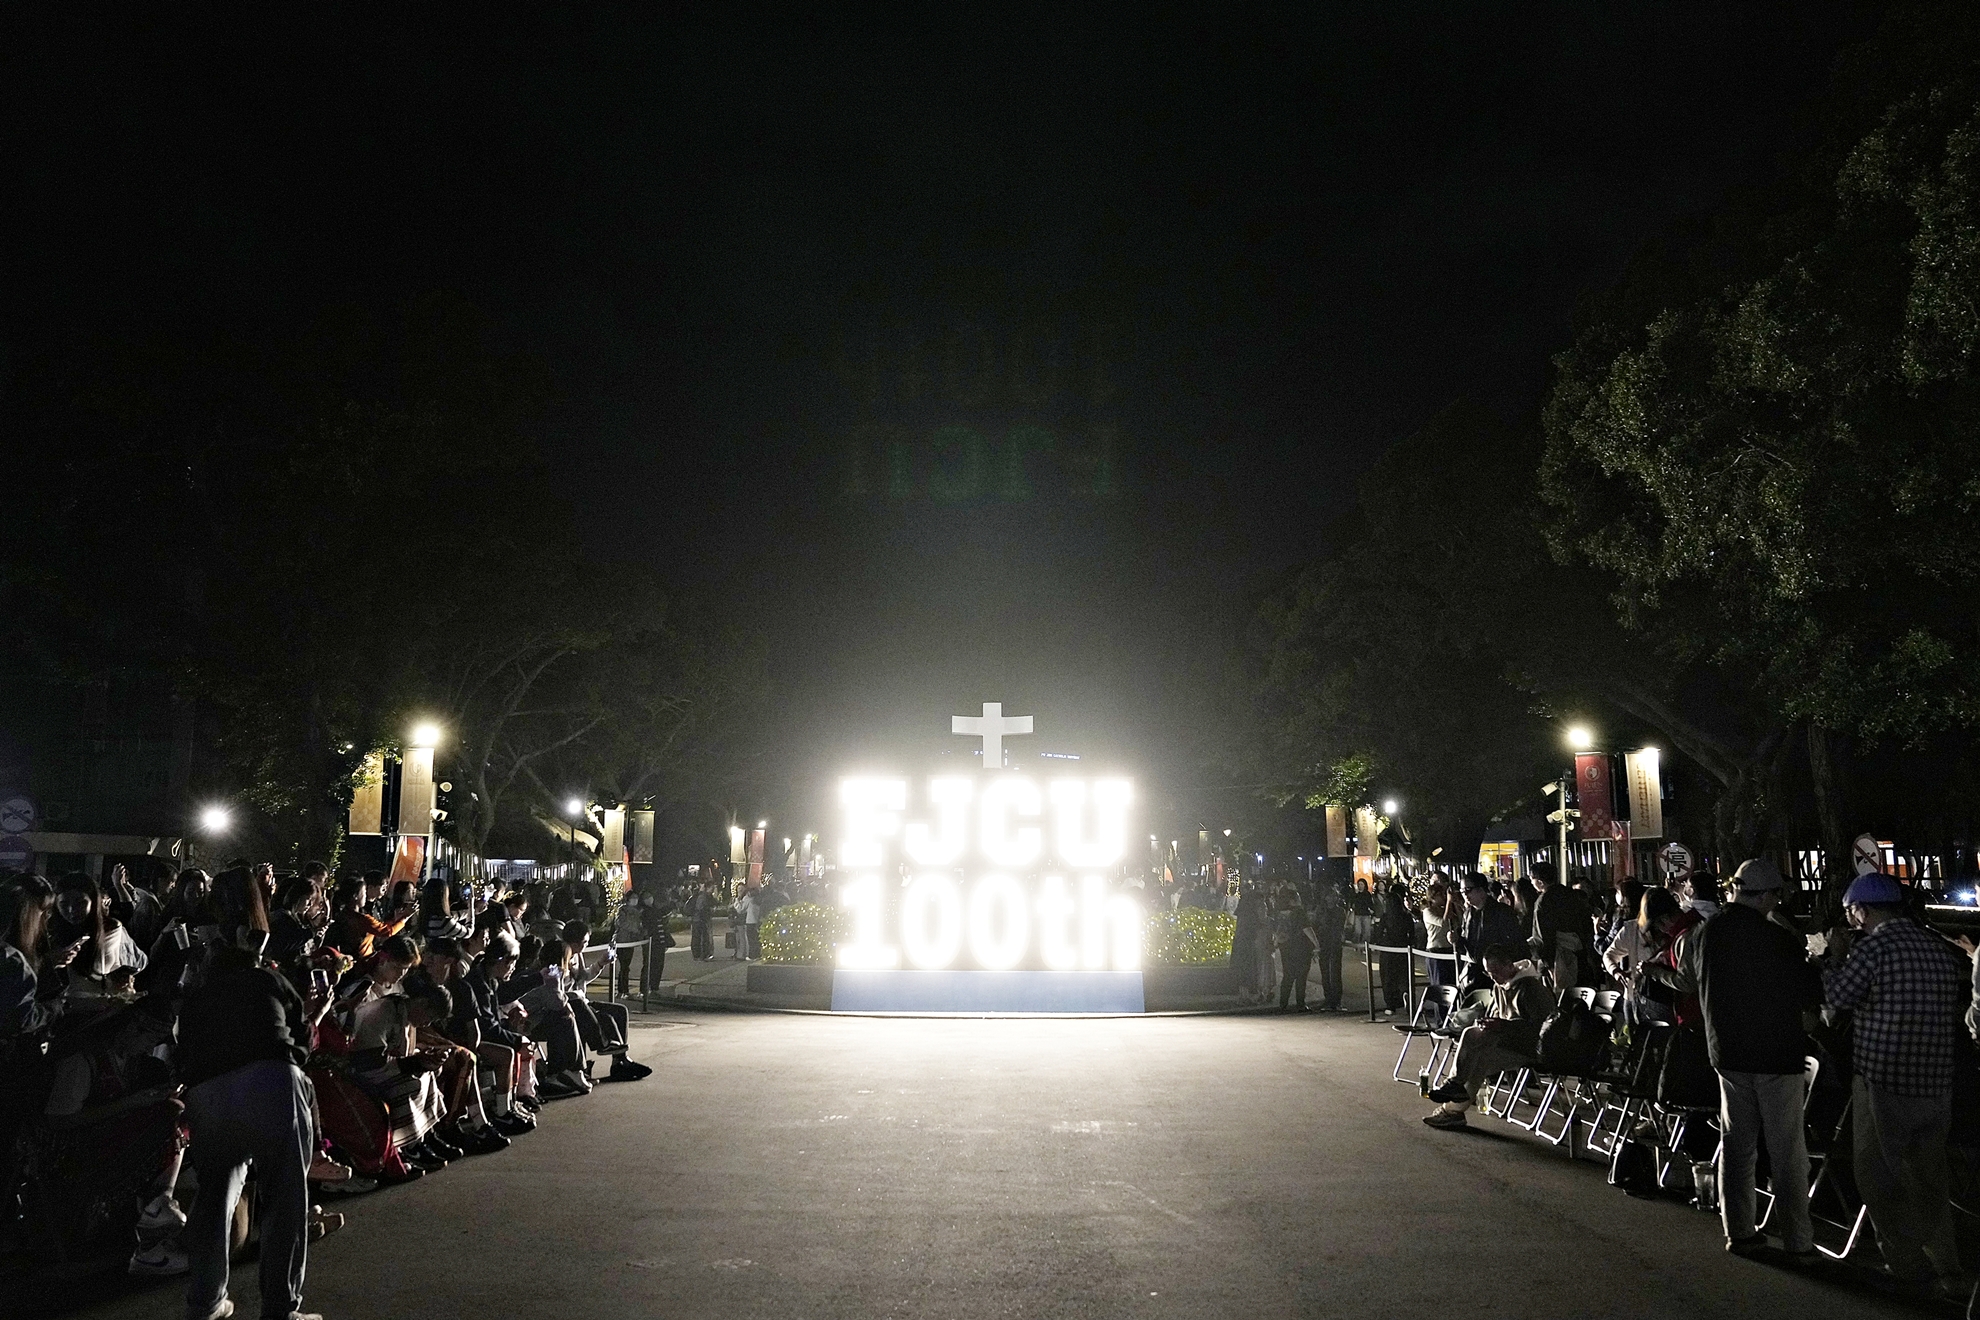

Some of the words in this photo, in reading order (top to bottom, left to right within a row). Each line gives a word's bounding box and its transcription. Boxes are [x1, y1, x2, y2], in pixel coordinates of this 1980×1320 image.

[841, 778, 1132, 866] FJCU
[1664, 850, 1688, 873] 停
[839, 873, 1141, 968] 100th
